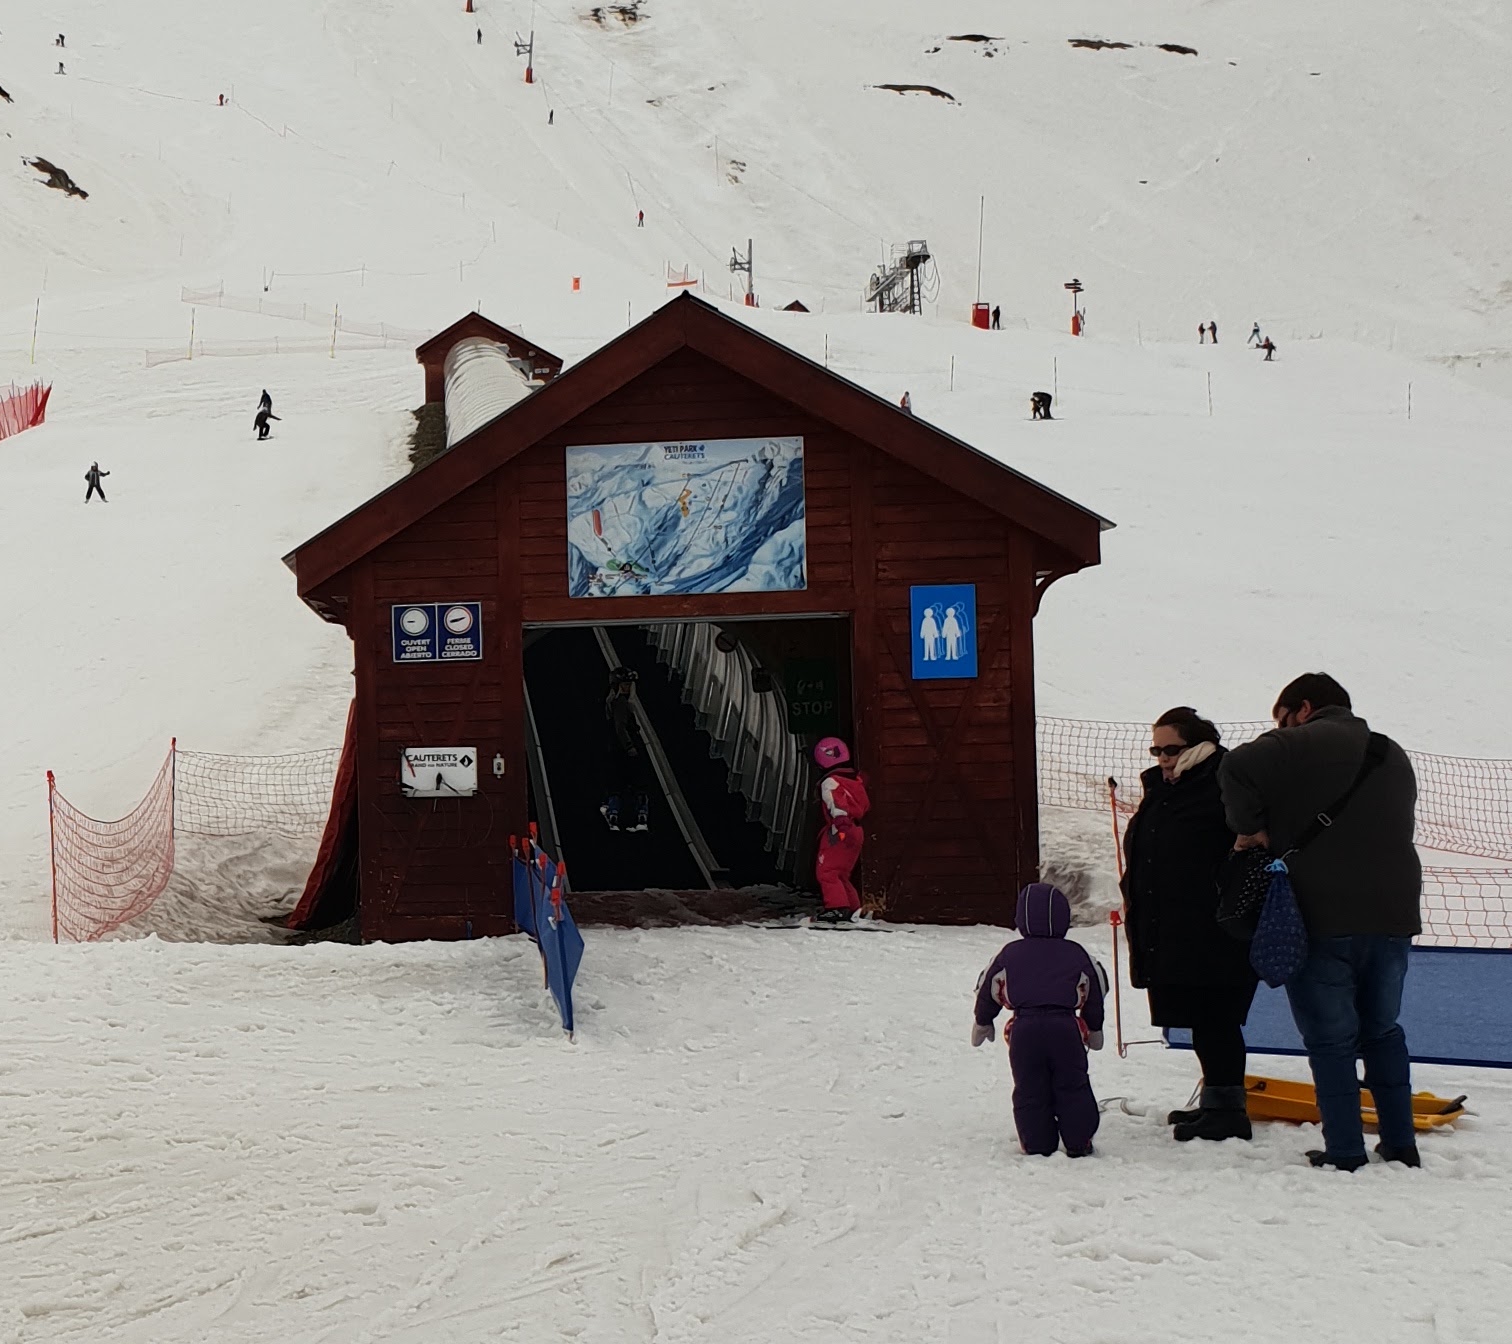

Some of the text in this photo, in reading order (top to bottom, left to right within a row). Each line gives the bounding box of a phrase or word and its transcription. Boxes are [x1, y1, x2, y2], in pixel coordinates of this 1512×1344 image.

[664, 444, 697, 453] YETI PARK
[664, 452, 705, 460] CAUTERETS
[441, 650, 478, 658] CERRADO
[792, 701, 832, 716] STOP
[407, 754, 457, 762] CAUTERETS
